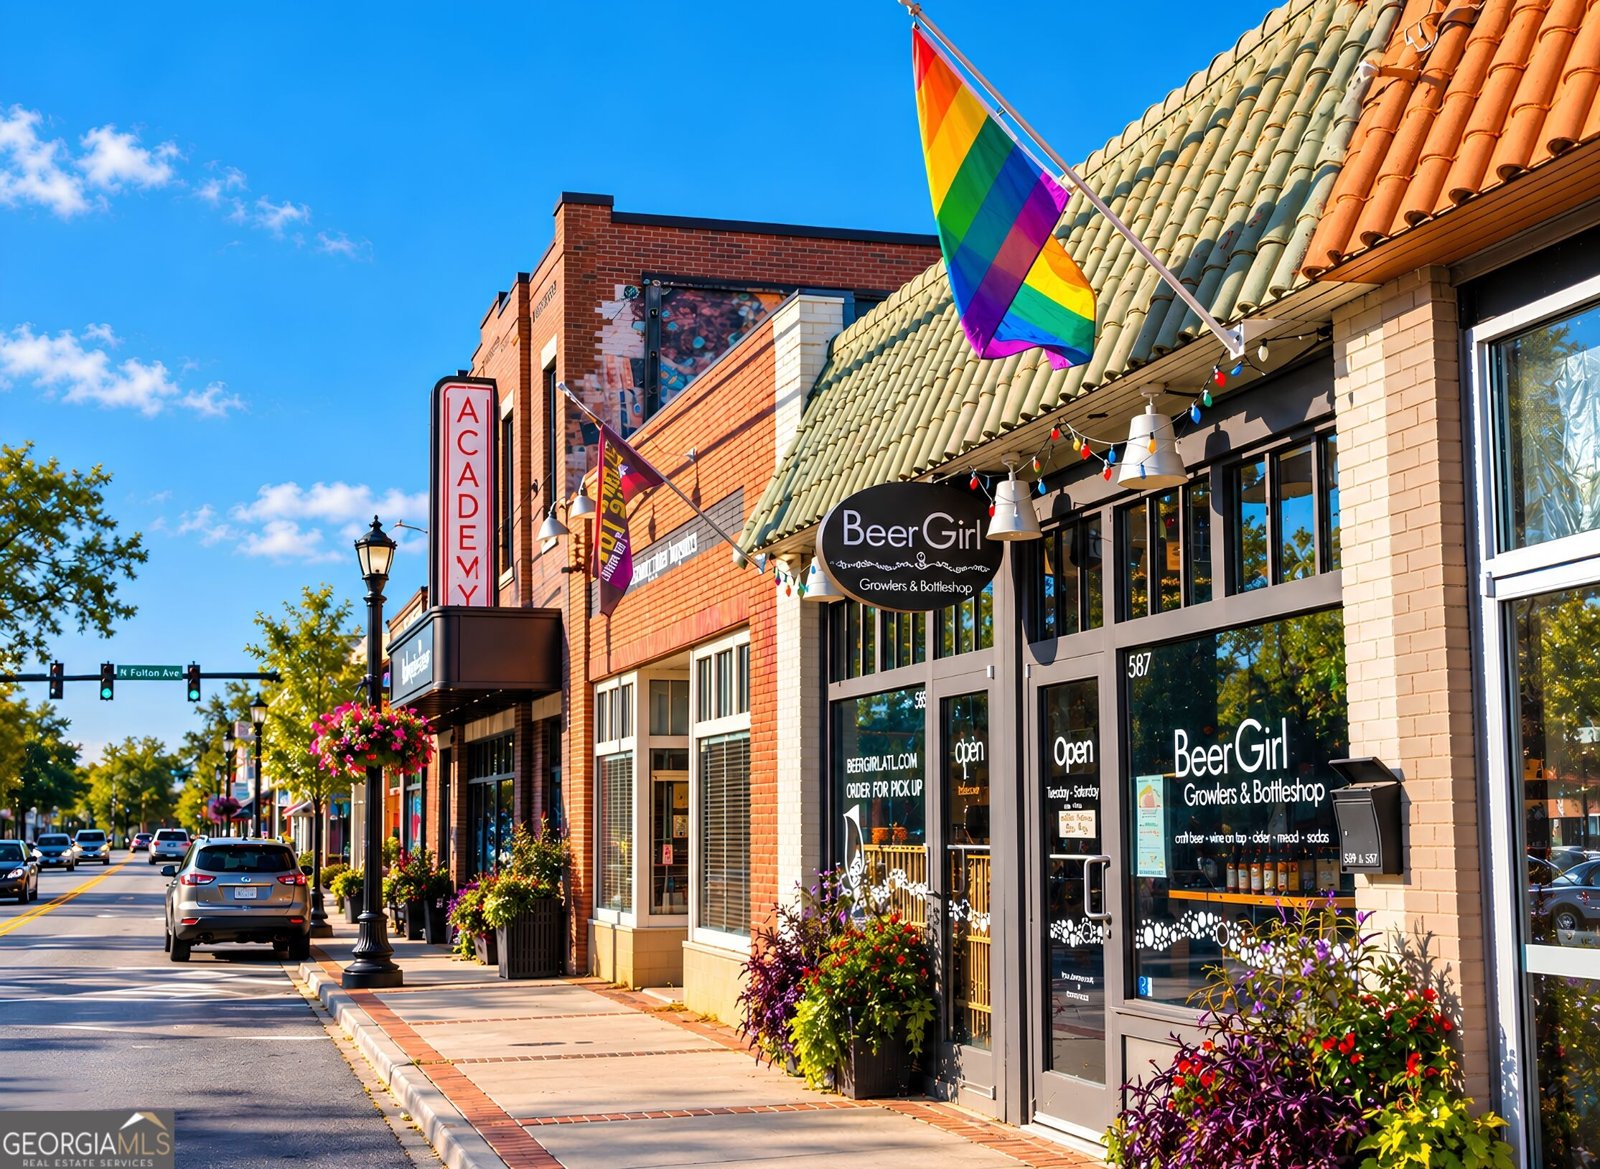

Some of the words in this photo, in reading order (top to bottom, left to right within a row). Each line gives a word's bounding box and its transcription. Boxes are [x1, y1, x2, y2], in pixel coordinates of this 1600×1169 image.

[456, 396, 480, 606] ACADEMY
[843, 509, 919, 548] Beer
[922, 511, 981, 550] Girl
[859, 578, 908, 592] Growlers
[910, 581, 918, 592] &
[920, 580, 973, 596] Bottleshop
[130, 668, 160, 677] Fulton
[162, 668, 180, 677] Ave
[1128, 652, 1151, 678] 587
[1054, 736, 1094, 774] Open
[1174, 728, 1232, 778] Beer
[1235, 717, 1288, 773] Girl
[846, 752, 918, 774] BEERGIRLATL.COM
[846, 782, 871, 798] ORDER
[872, 780, 889, 798] FOR
[890, 779, 911, 797] PICK
[911, 779, 923, 797] UP
[1184, 782, 1237, 806] Growlers
[1241, 782, 1251, 804] &
[1253, 777, 1325, 808] Bottleshop
